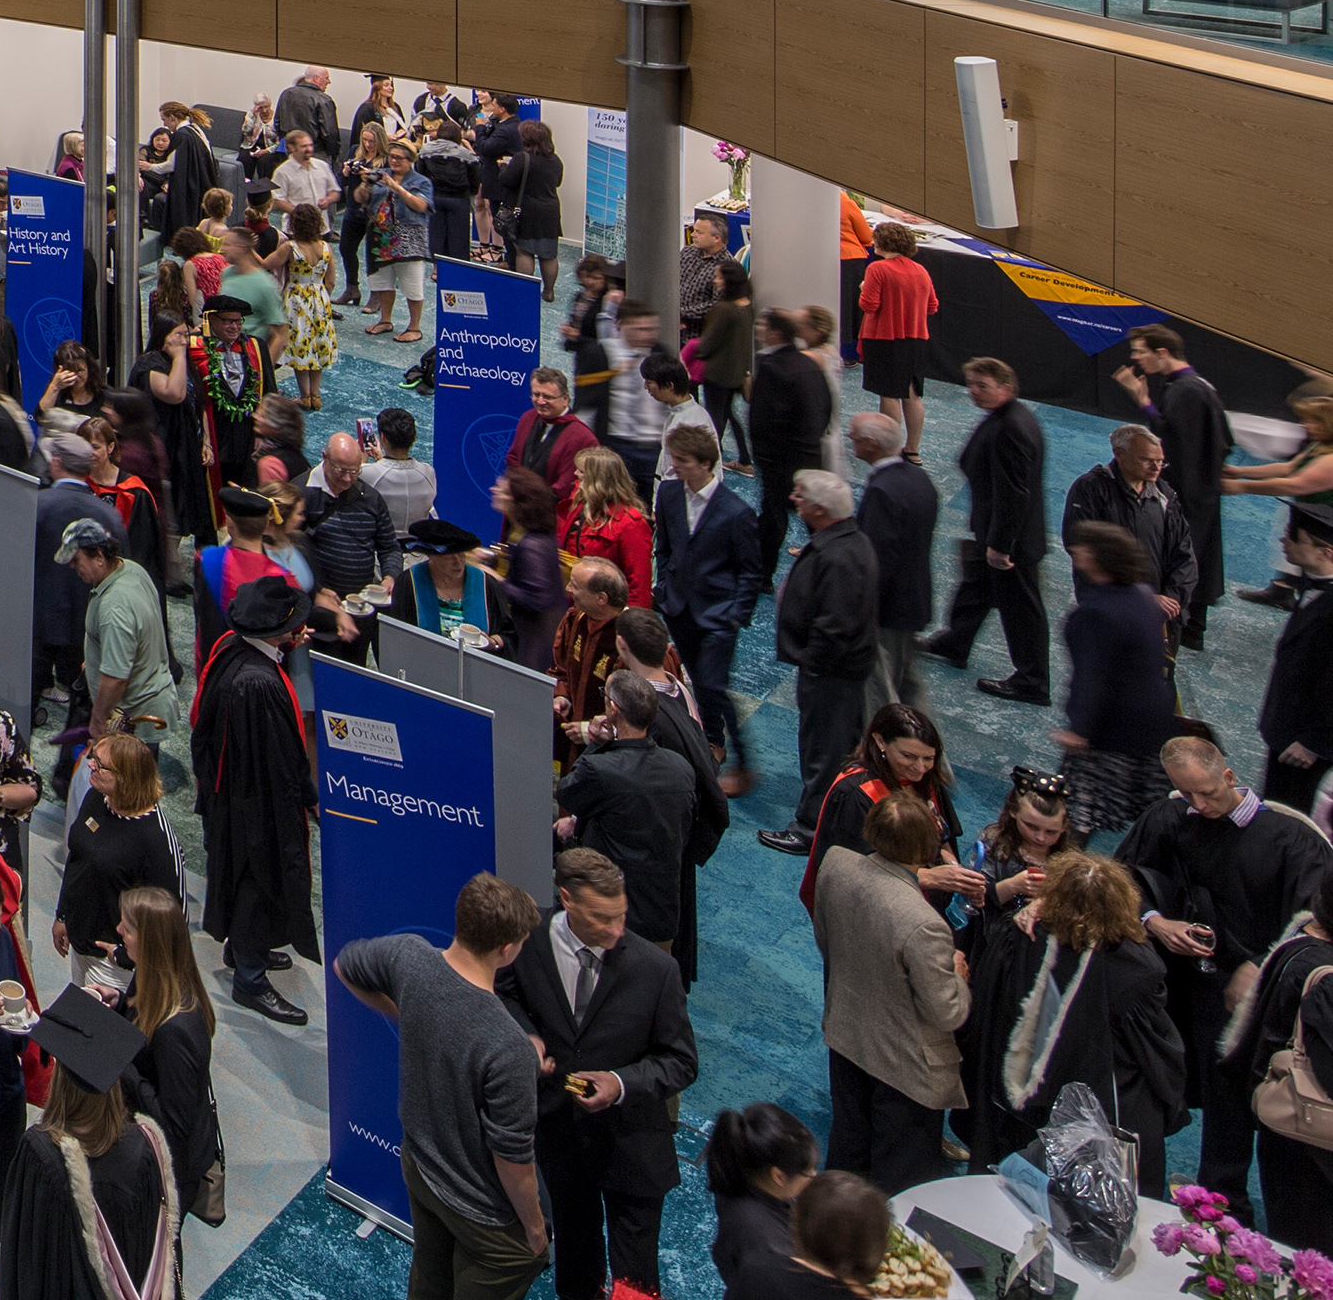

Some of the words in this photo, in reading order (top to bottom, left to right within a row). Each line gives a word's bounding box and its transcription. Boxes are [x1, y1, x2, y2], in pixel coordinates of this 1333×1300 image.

[595, 120, 625, 132] daring
[597, 112, 615, 122] 150
[9, 226, 48, 244] History
[51, 230, 71, 242] and
[8, 241, 27, 254] Art
[29, 242, 69, 260] History
[1019, 272, 1051, 283] Career
[1053, 278, 1115, 297] Development
[440, 328, 537, 353] Anthropology
[439, 346, 463, 360] and
[439, 361, 526, 386] Archaeology
[352, 726, 394, 744] OTAGO
[326, 771, 484, 827] Management
